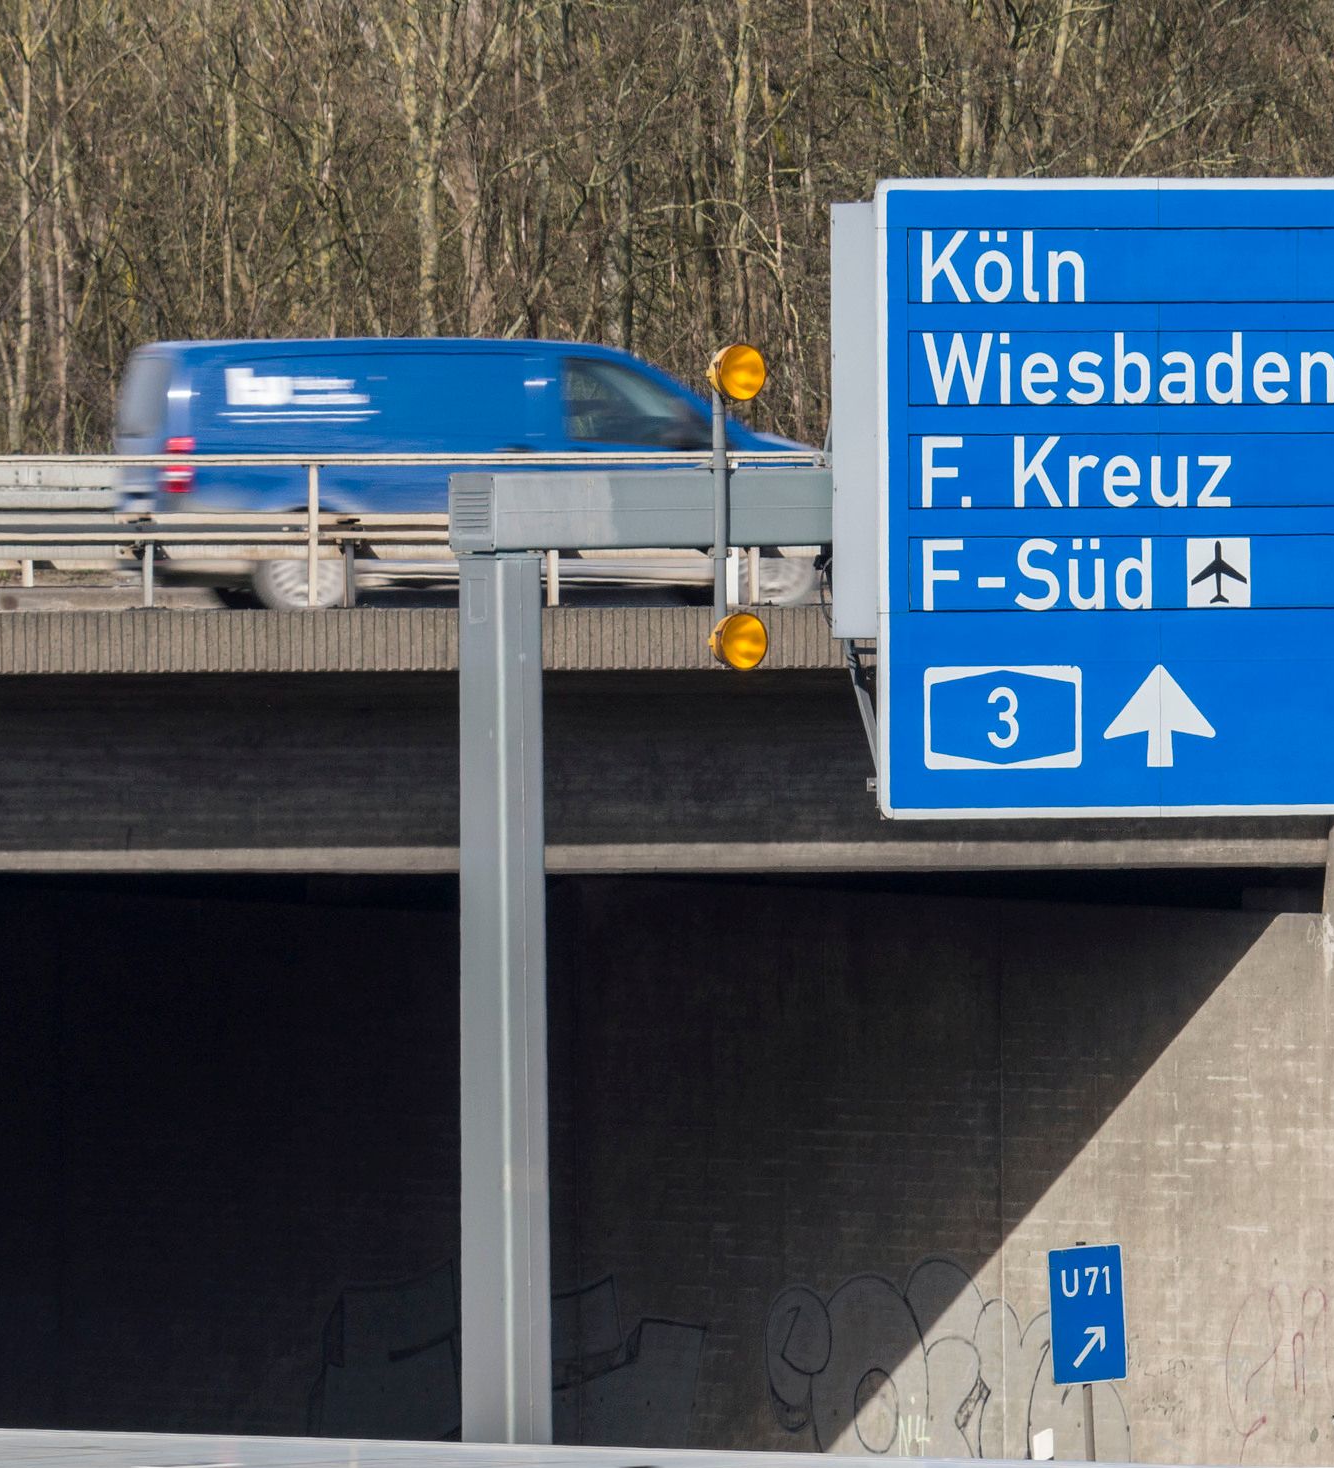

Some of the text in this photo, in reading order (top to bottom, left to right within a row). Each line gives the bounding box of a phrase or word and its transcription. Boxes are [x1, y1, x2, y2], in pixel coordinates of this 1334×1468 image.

[921, 230, 1085, 303] Köln
[922, 435, 1232, 508] F. Kreuz
[922, 536, 1154, 611] F-Süd
[987, 685, 1020, 749] 3
